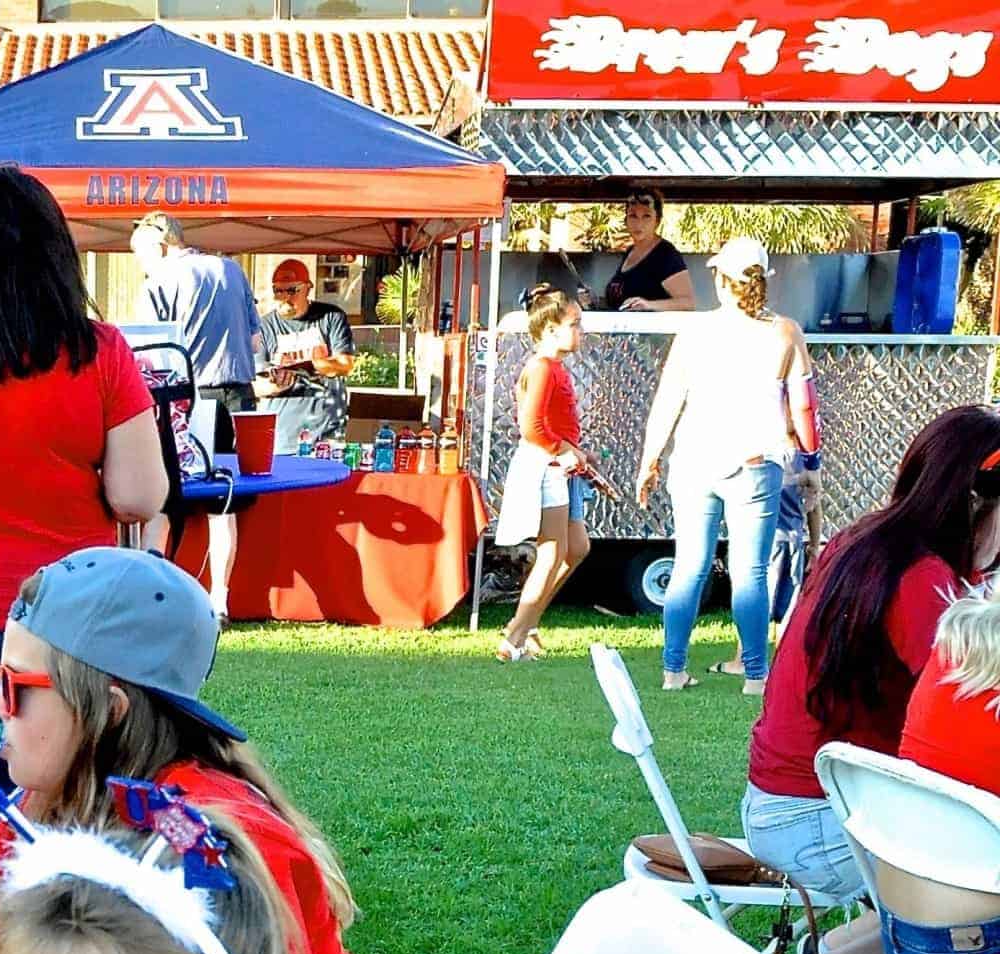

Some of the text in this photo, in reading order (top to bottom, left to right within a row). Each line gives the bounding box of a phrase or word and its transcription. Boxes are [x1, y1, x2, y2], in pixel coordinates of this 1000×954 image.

[798, 17, 993, 92] Dogs
[76, 68, 248, 140] A
[86, 174, 229, 205] ARIZONA
